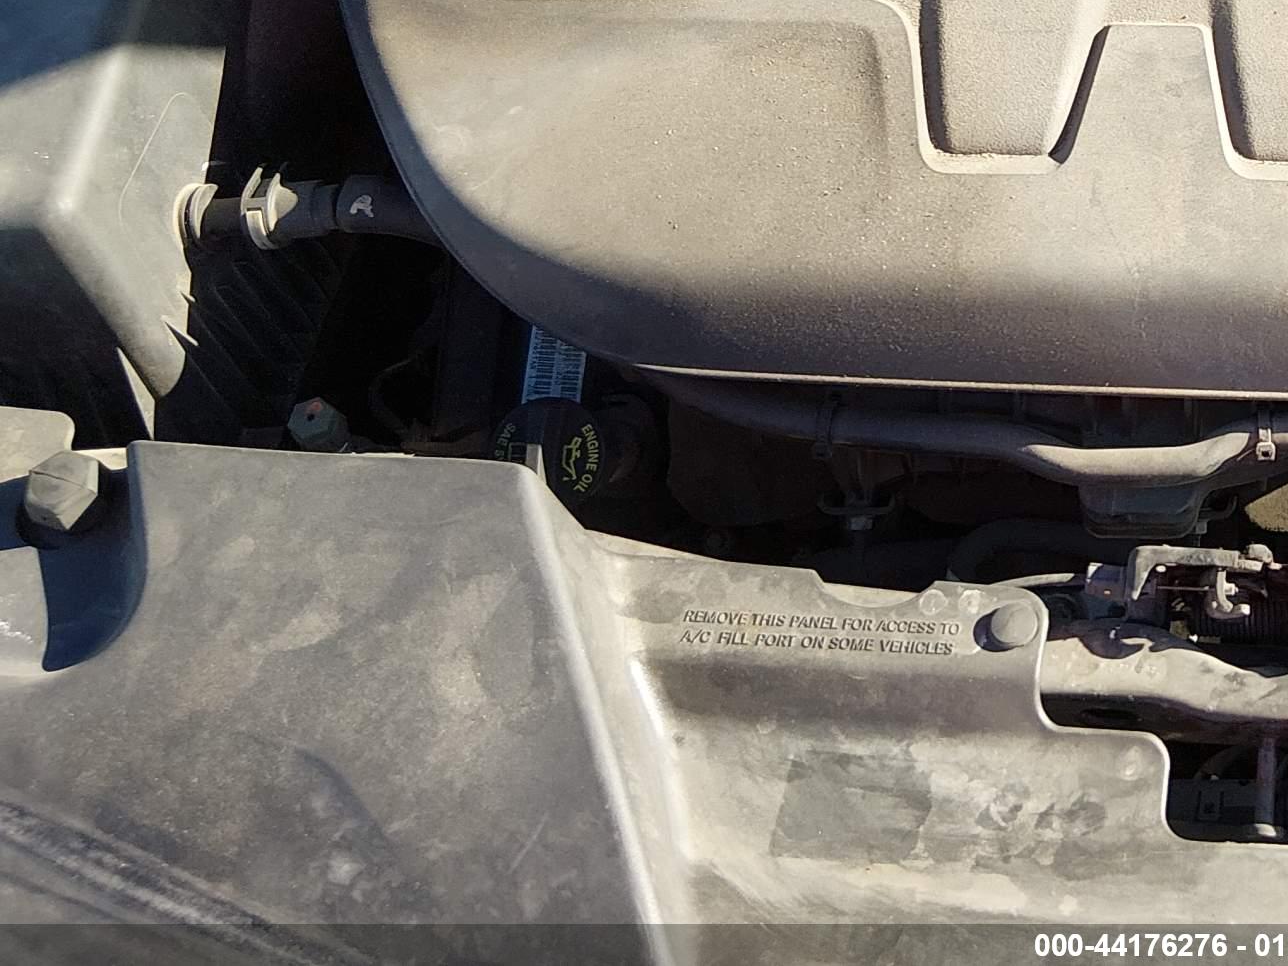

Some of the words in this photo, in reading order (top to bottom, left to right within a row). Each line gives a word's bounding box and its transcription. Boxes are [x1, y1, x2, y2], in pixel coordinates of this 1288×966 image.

[581, 424, 600, 472] ENGINE
[573, 473, 593, 493] OIL
[683, 609, 748, 626] REMOVE
[751, 613, 786, 627] THIS
[789, 615, 838, 630] PANEL
[842, 617, 873, 631] FOR
[876, 619, 937, 634] ACCESS
[940, 622, 960, 635] TO
[680, 629, 711, 644] A/C
[717, 631, 750, 646] FILL
[755, 633, 796, 648] PORT
[800, 635, 825, 650] ON
[828, 637, 874, 652] SOME
[879, 639, 954, 655] VEHICLES
